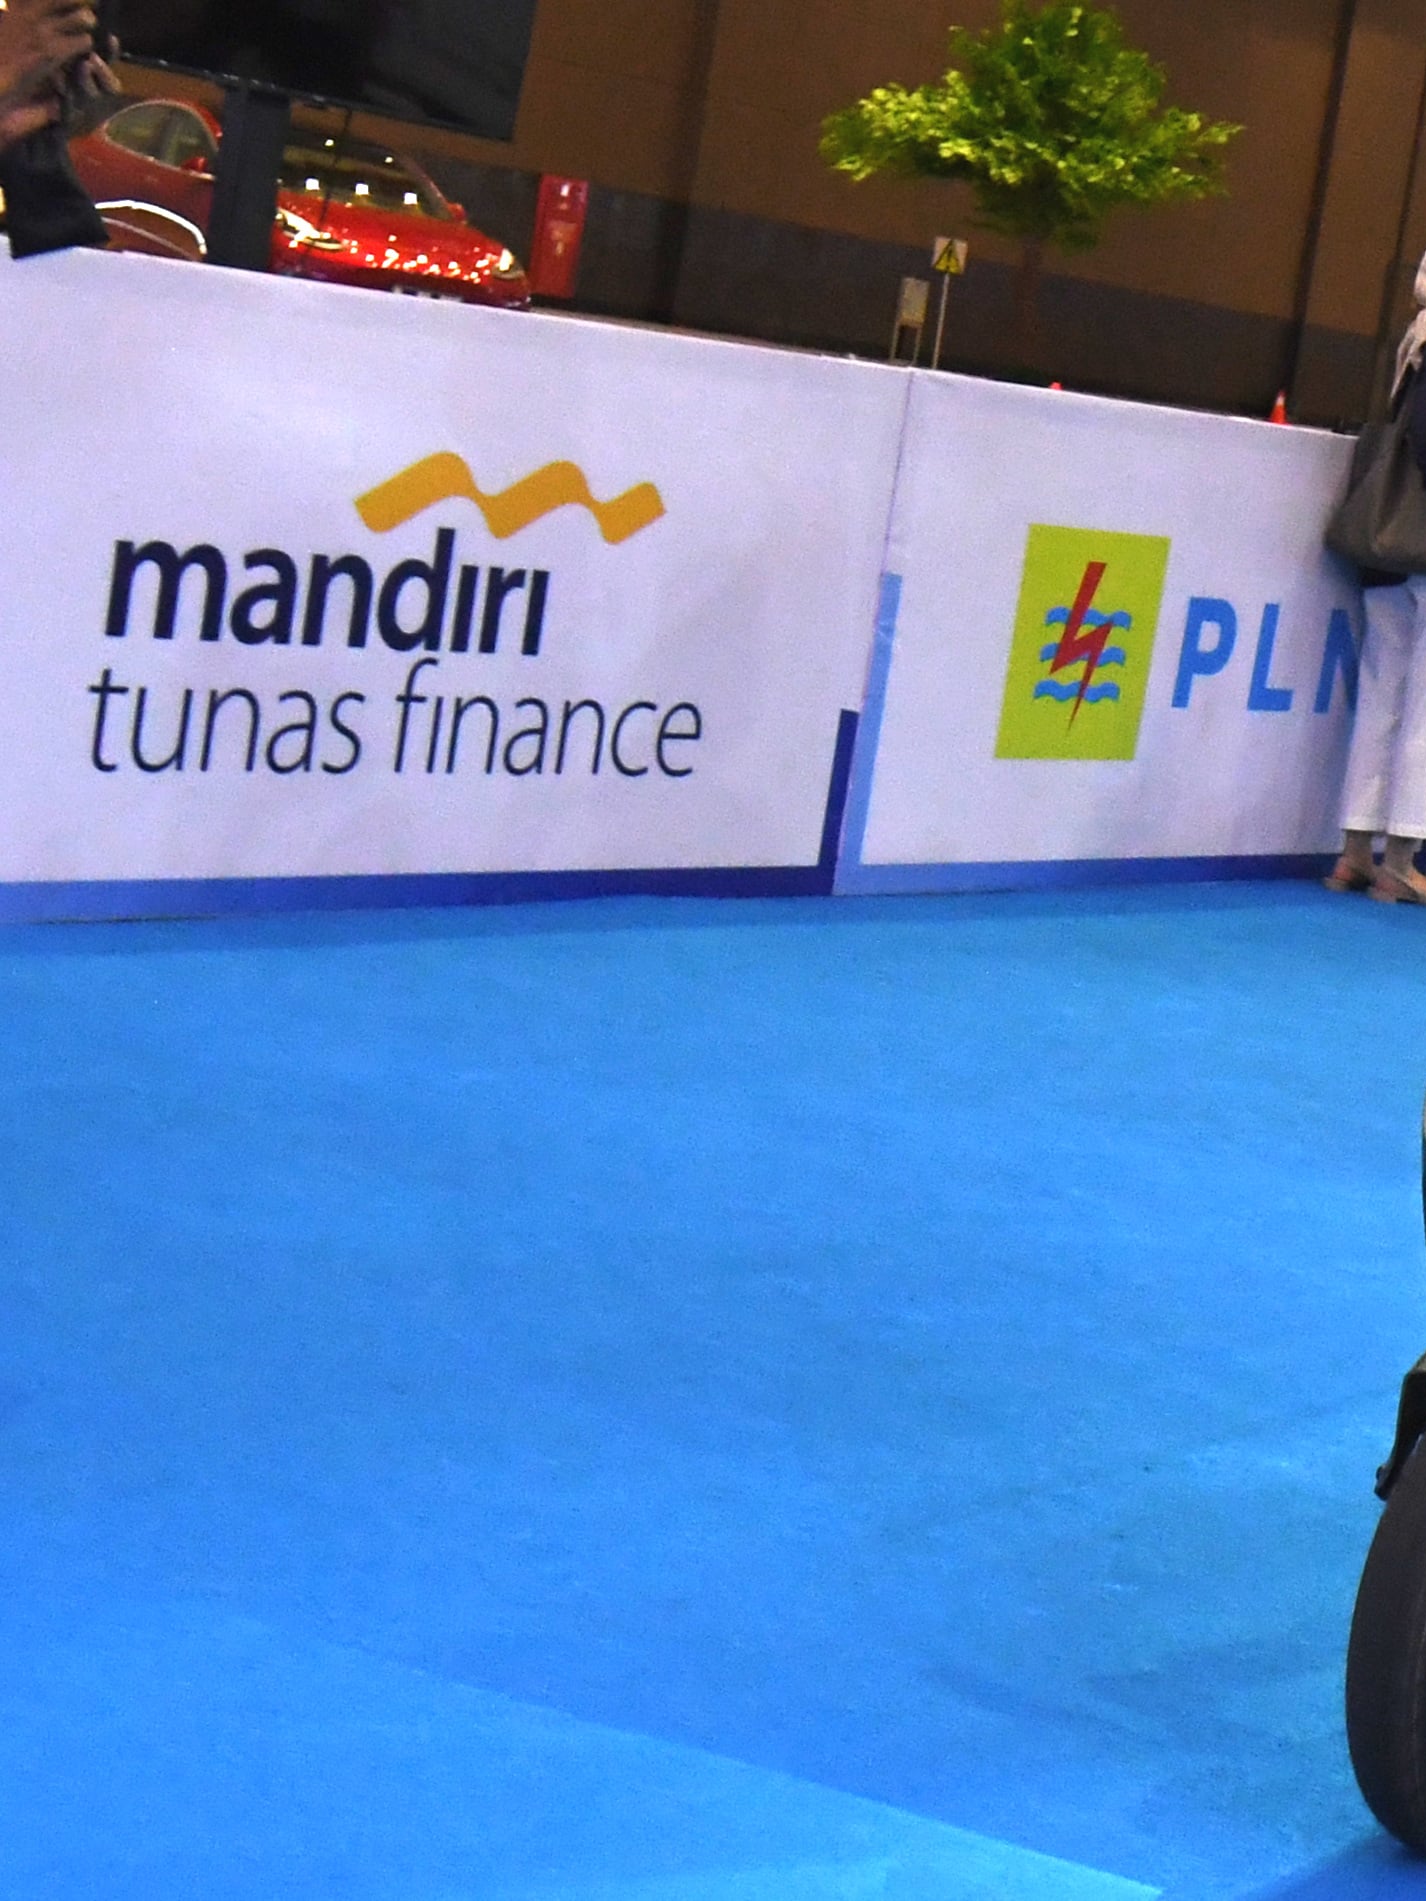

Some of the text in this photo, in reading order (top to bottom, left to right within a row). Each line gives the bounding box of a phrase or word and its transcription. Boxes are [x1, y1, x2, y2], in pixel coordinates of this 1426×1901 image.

[104, 527, 549, 656] mandiri
[89, 658, 701, 777] tunas finance
